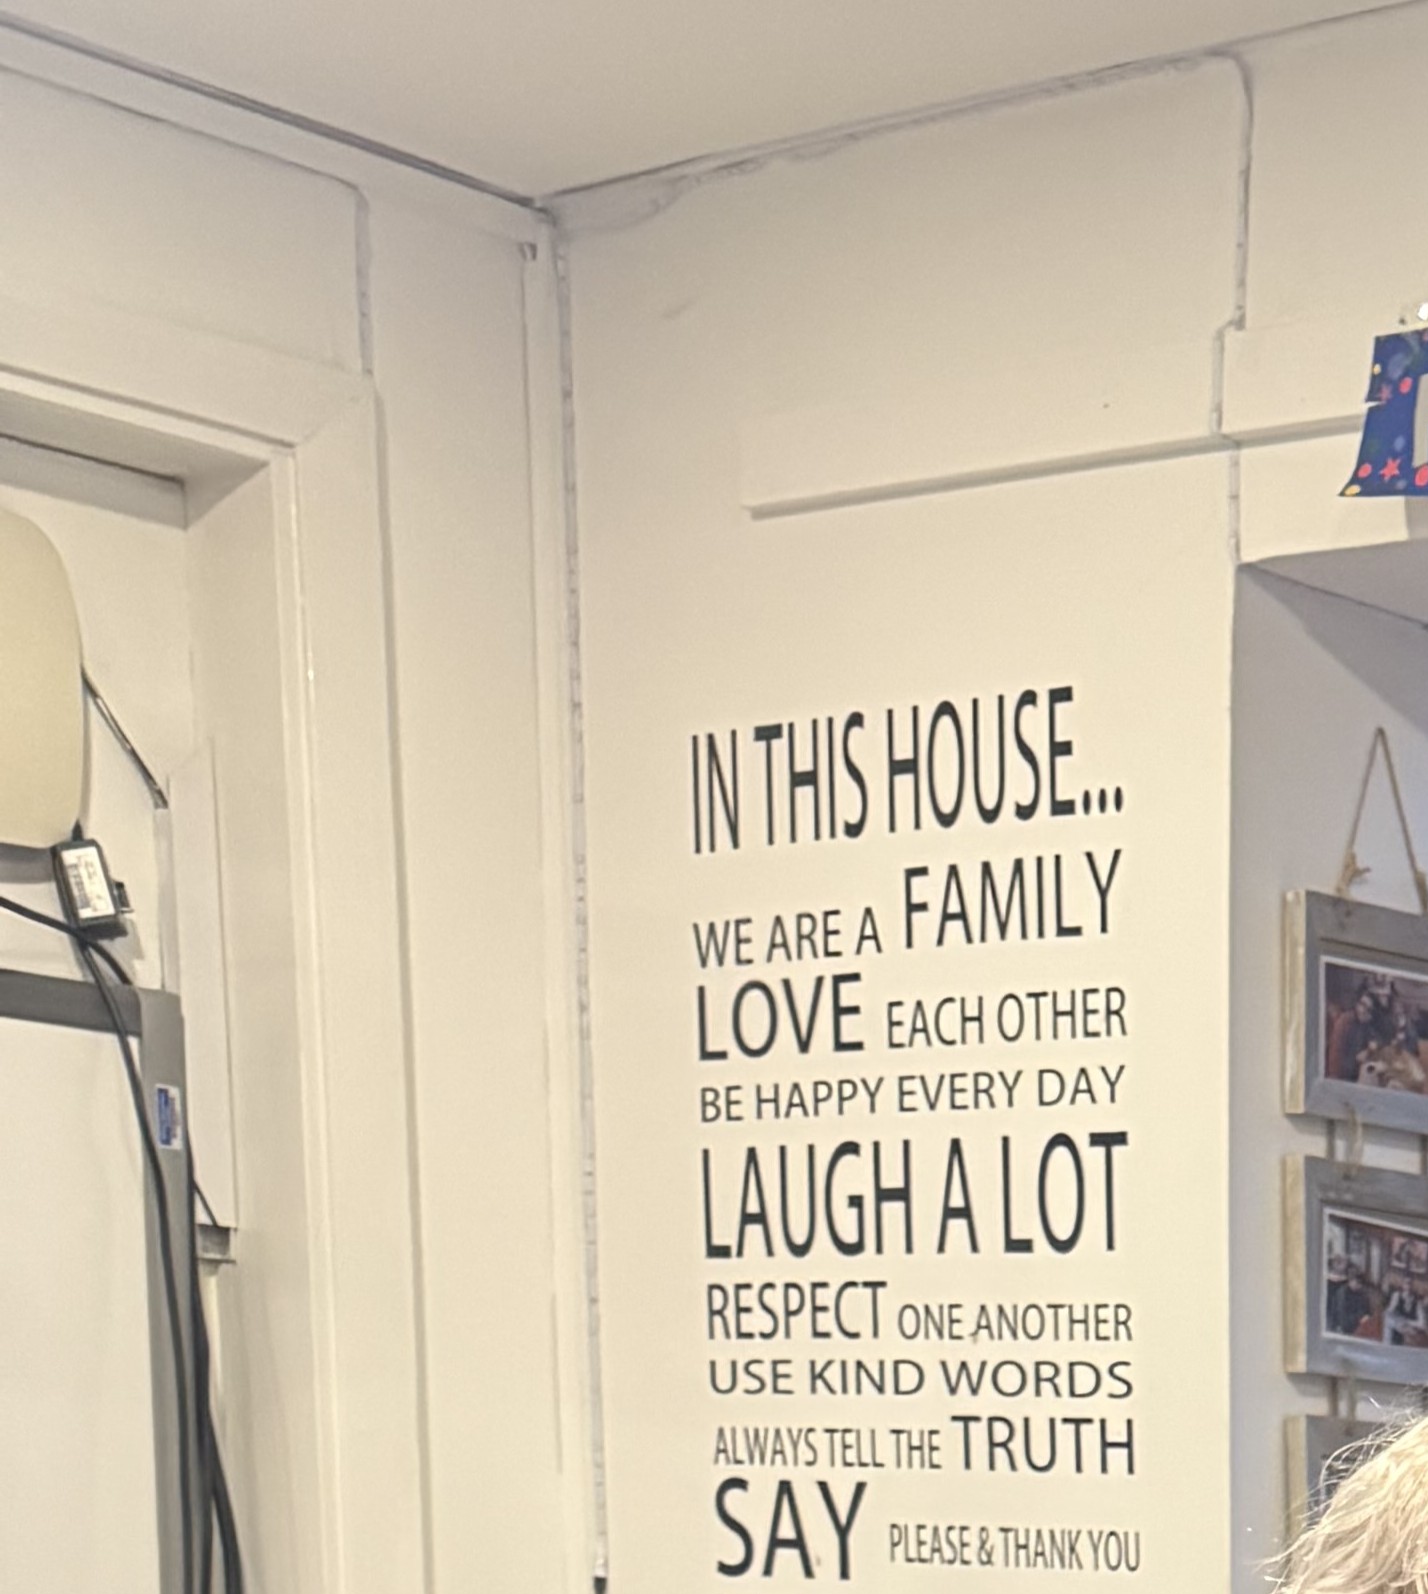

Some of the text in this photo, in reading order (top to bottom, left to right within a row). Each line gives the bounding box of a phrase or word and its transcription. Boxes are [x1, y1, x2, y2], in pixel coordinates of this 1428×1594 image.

[691, 685, 1124, 855] IN THIS HOUSE...
[692, 848, 1123, 969] WE ARE A FAMILY
[697, 971, 1128, 1062] LOVE EACH OTHER
[700, 1064, 1126, 1124] BE HAPPY EVERY DAY
[701, 1130, 1129, 1260] LAUGH A LOT
[706, 1280, 1133, 1342] RESPECT ONE ANOTHER
[709, 1358, 1134, 1400] USE KIND WORDS
[713, 1414, 1135, 1476] ALWAYS TELL THE TRUTH
[714, 1476, 1141, 1581] SAY PLEASE & THANK YOU
